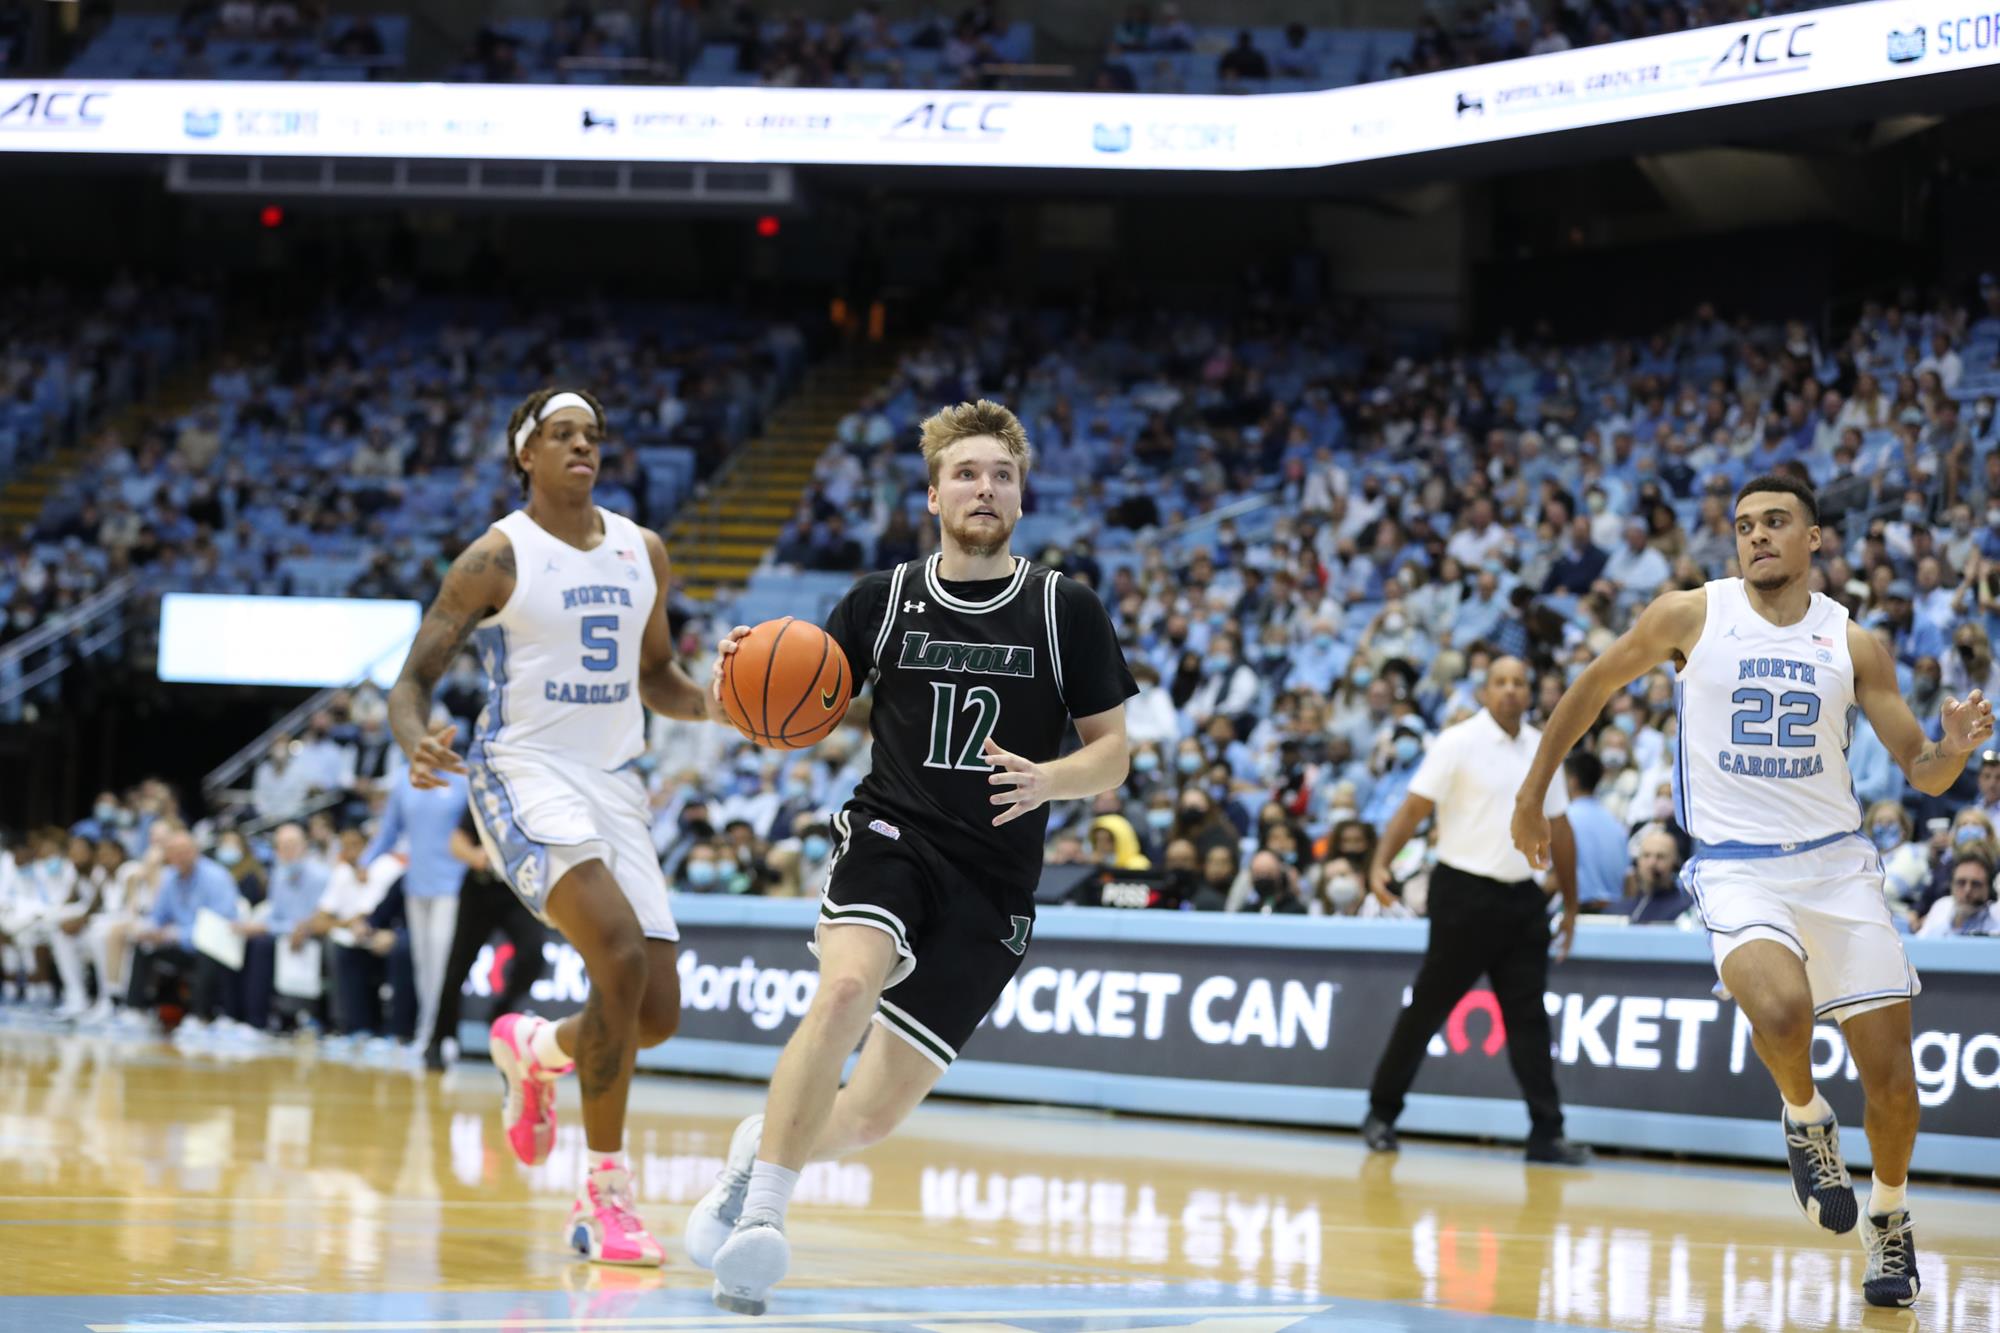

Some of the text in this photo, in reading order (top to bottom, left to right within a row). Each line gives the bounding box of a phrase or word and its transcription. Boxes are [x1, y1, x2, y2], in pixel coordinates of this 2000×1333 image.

[1708, 20, 1819, 73] ACC
[888, 101, 1012, 134] ACC
[561, 585, 633, 610] NORTH
[581, 615, 619, 672] 5
[1738, 657, 1816, 686] NORTH
[922, 681, 1001, 772] 12
[1731, 687, 1821, 747] 22
[1718, 750, 1824, 779] CAROLINA
[1190, 975, 1333, 1051] CAN
